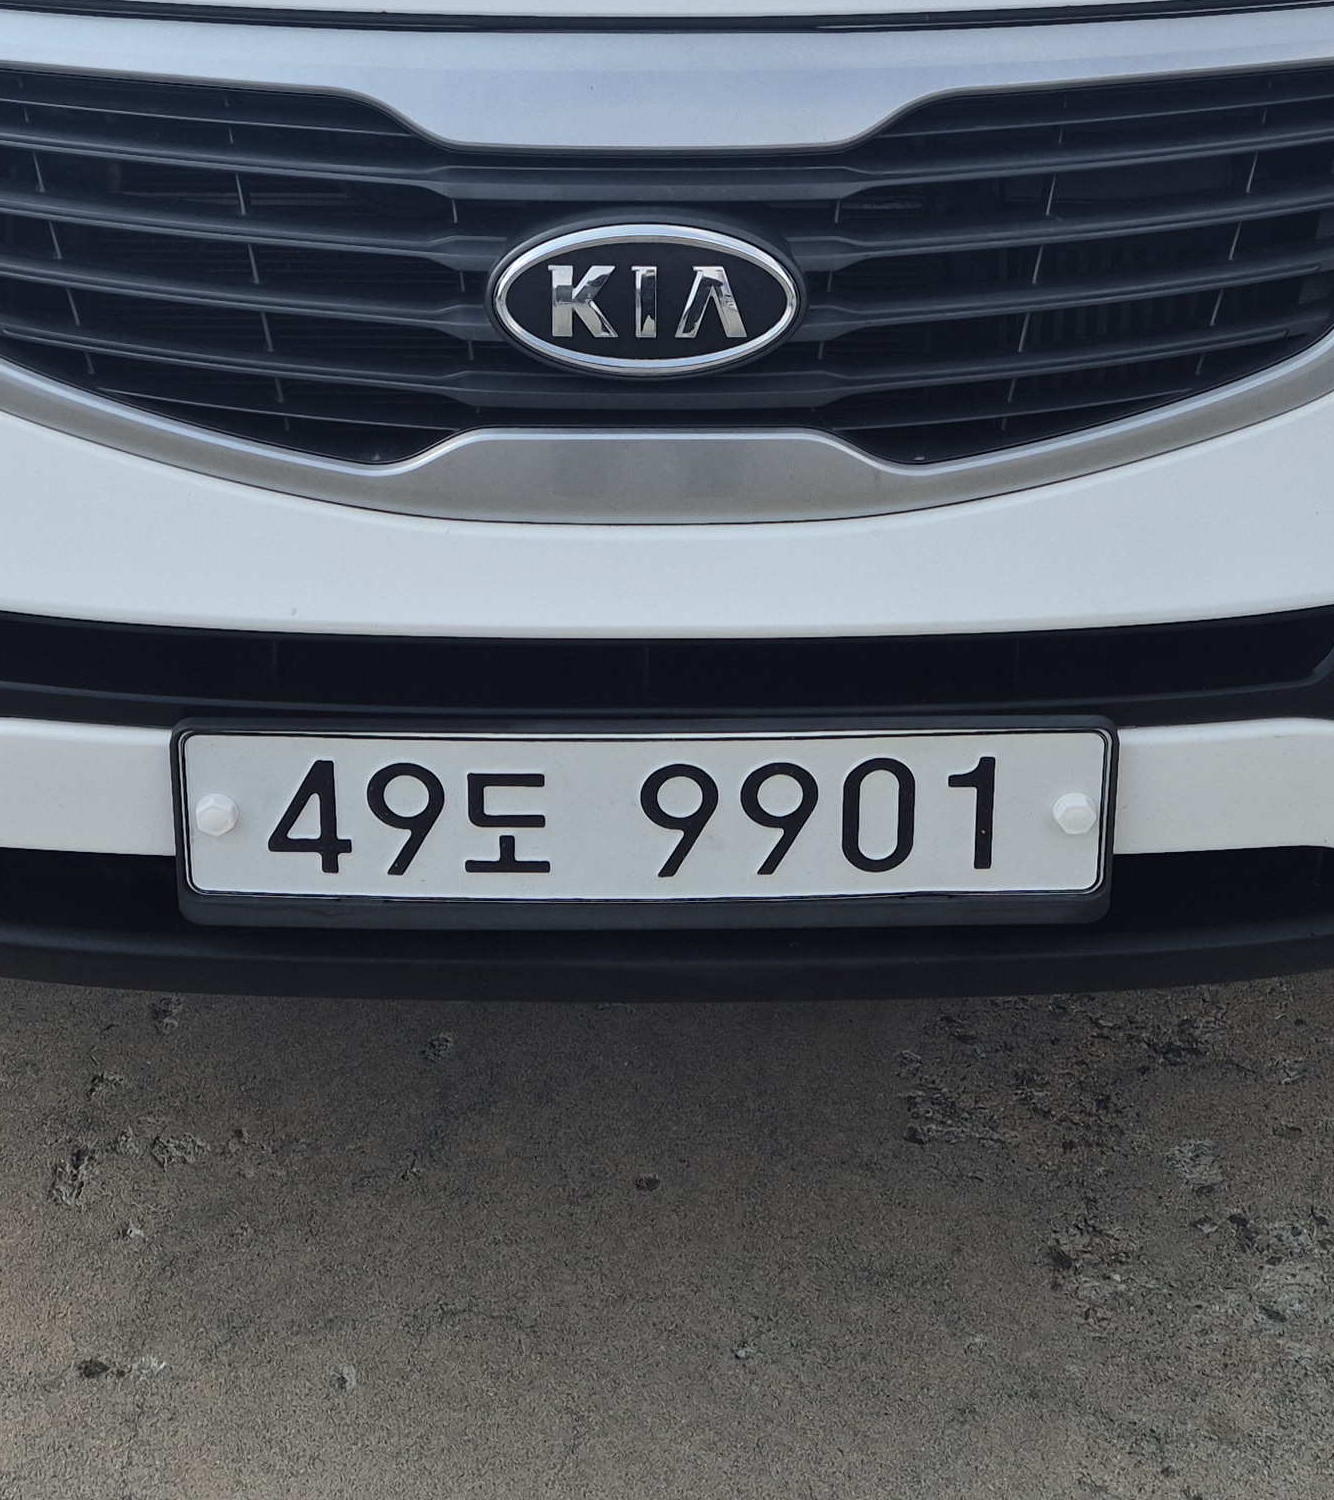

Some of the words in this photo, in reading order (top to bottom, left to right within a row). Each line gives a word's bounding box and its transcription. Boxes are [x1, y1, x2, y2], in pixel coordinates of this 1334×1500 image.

[547, 264, 748, 339] KIA
[267, 758, 551, 876] 49도
[639, 756, 997, 878] 9901
